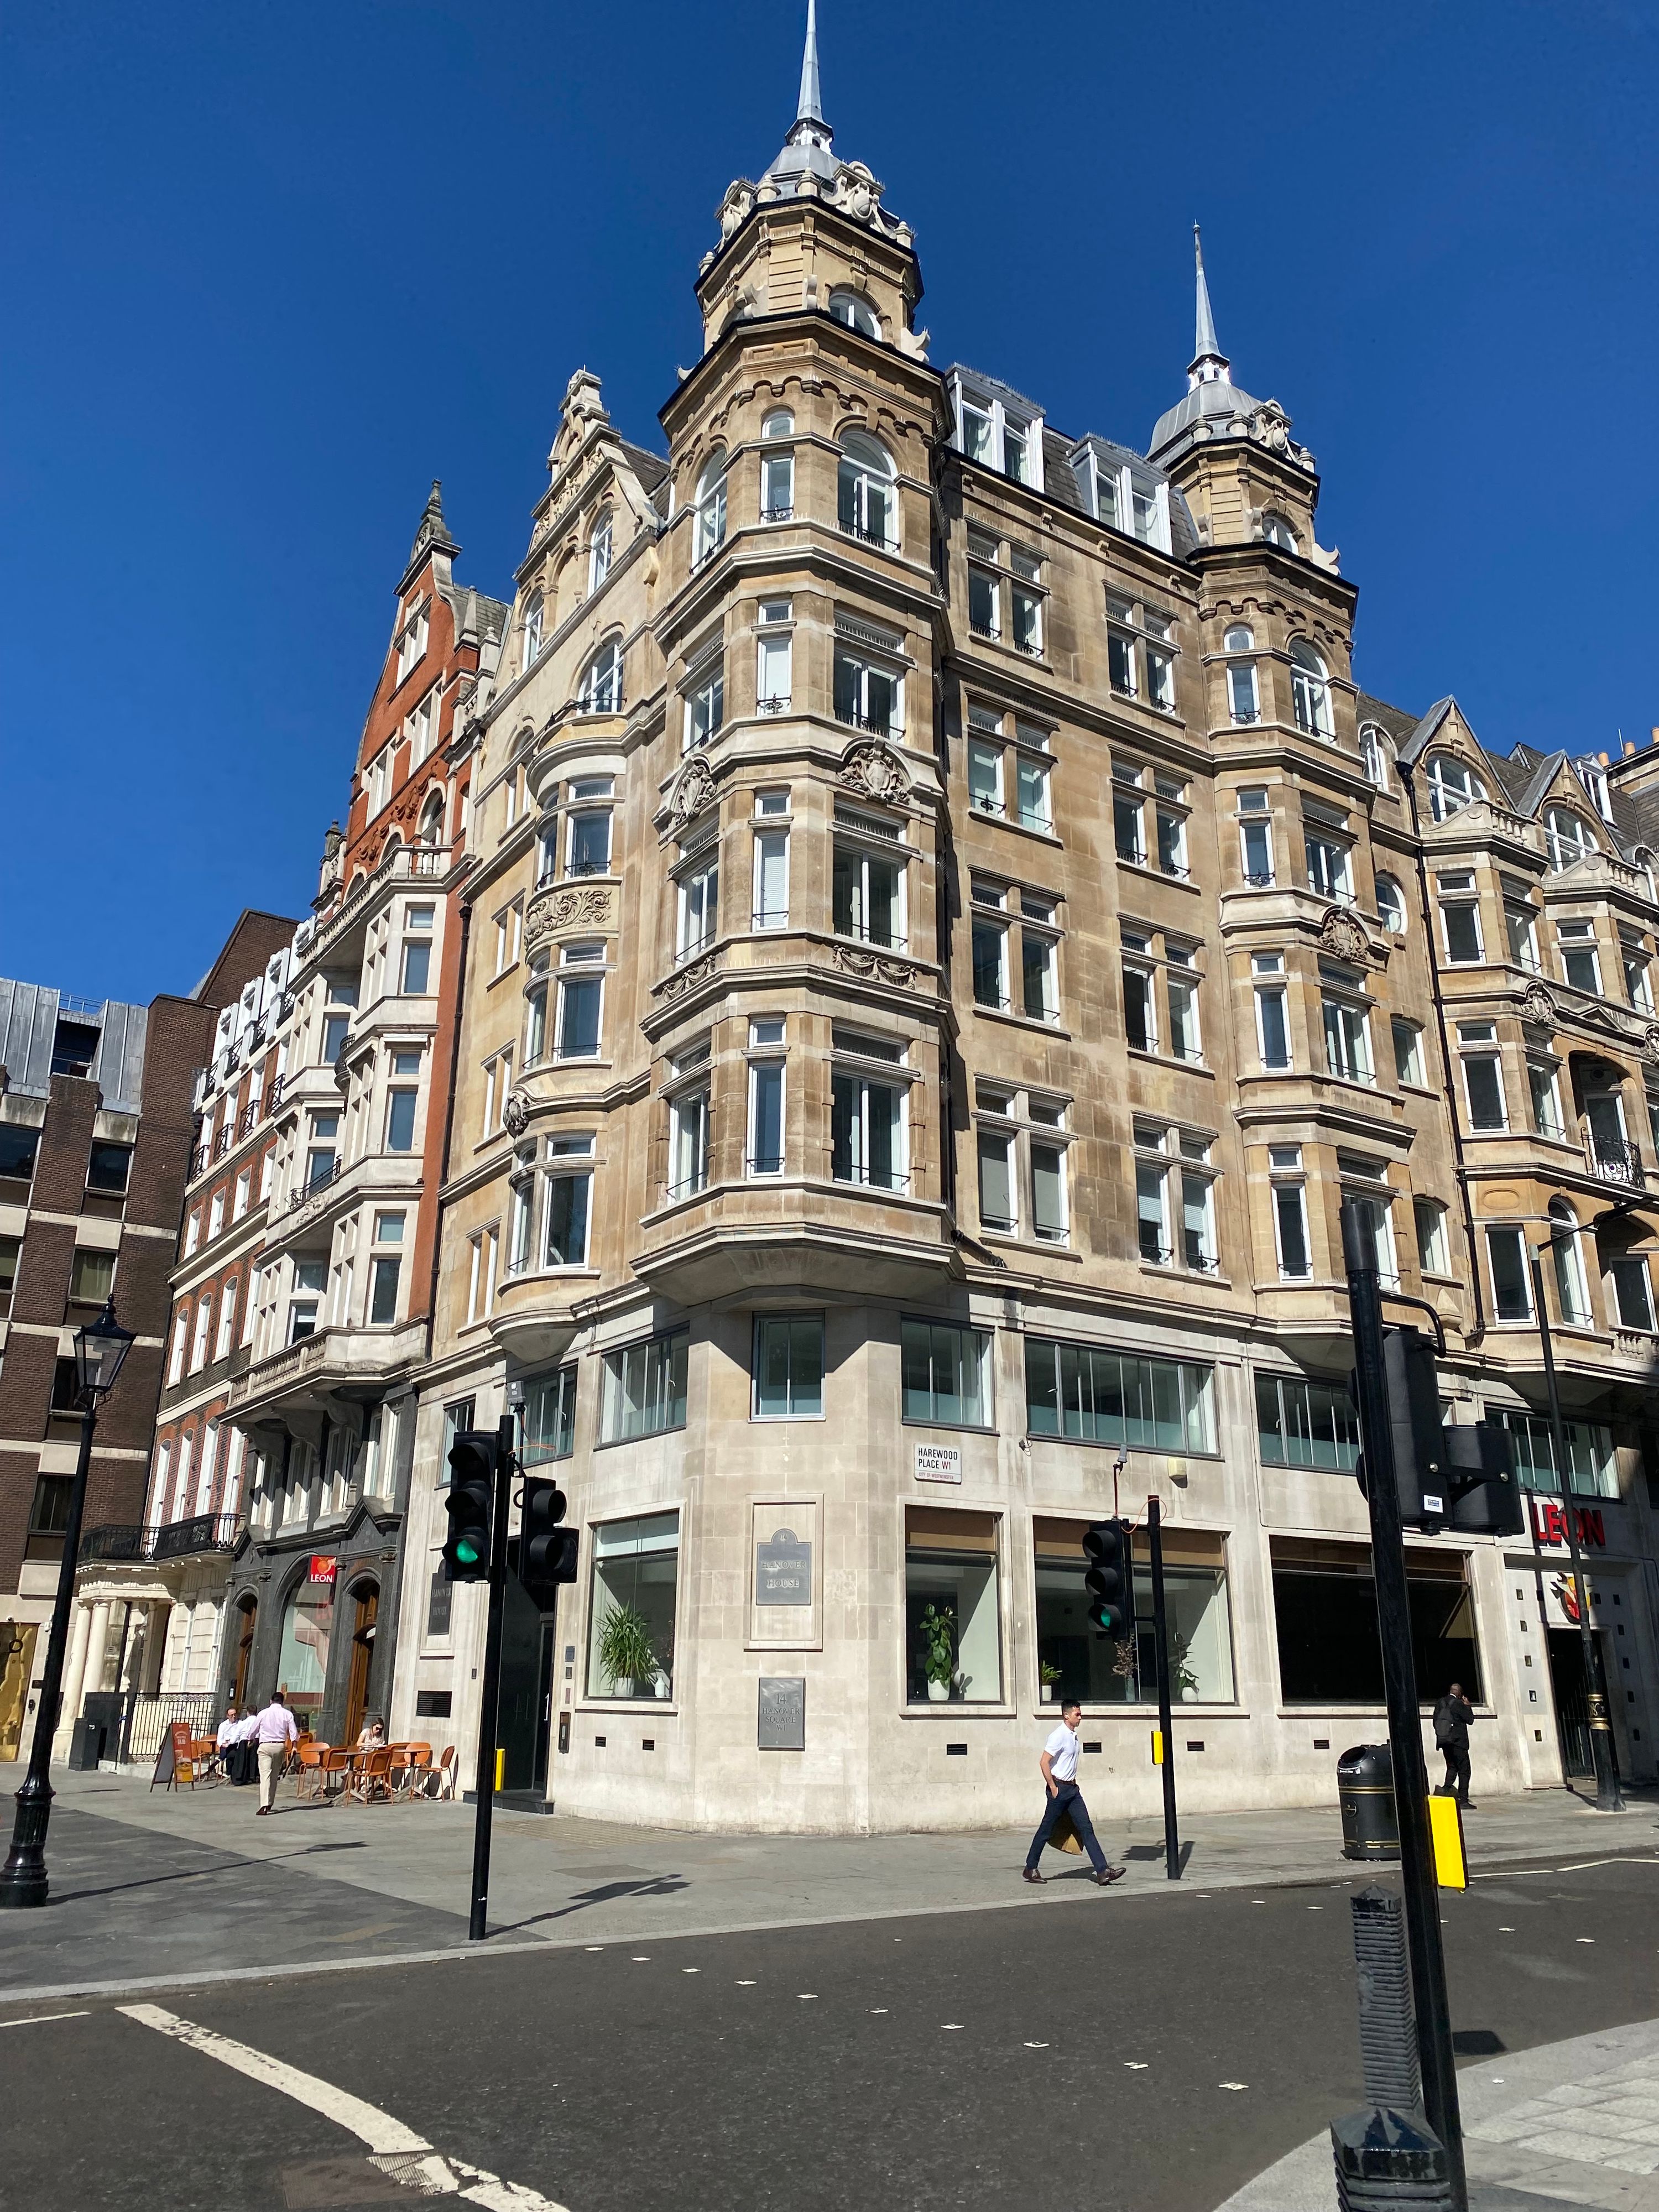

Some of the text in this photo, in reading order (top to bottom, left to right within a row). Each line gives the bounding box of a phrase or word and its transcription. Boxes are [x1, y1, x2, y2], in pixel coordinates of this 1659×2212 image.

[919, 1448, 957, 1460] HAREWOOD
[919, 1459, 951, 1470] PLACE W1
[761, 1560, 806, 1569] HANOVER
[310, 1574, 333, 1583] LEON
[767, 1579, 799, 1588] HOUSE
[776, 1693, 786, 1704] 14
